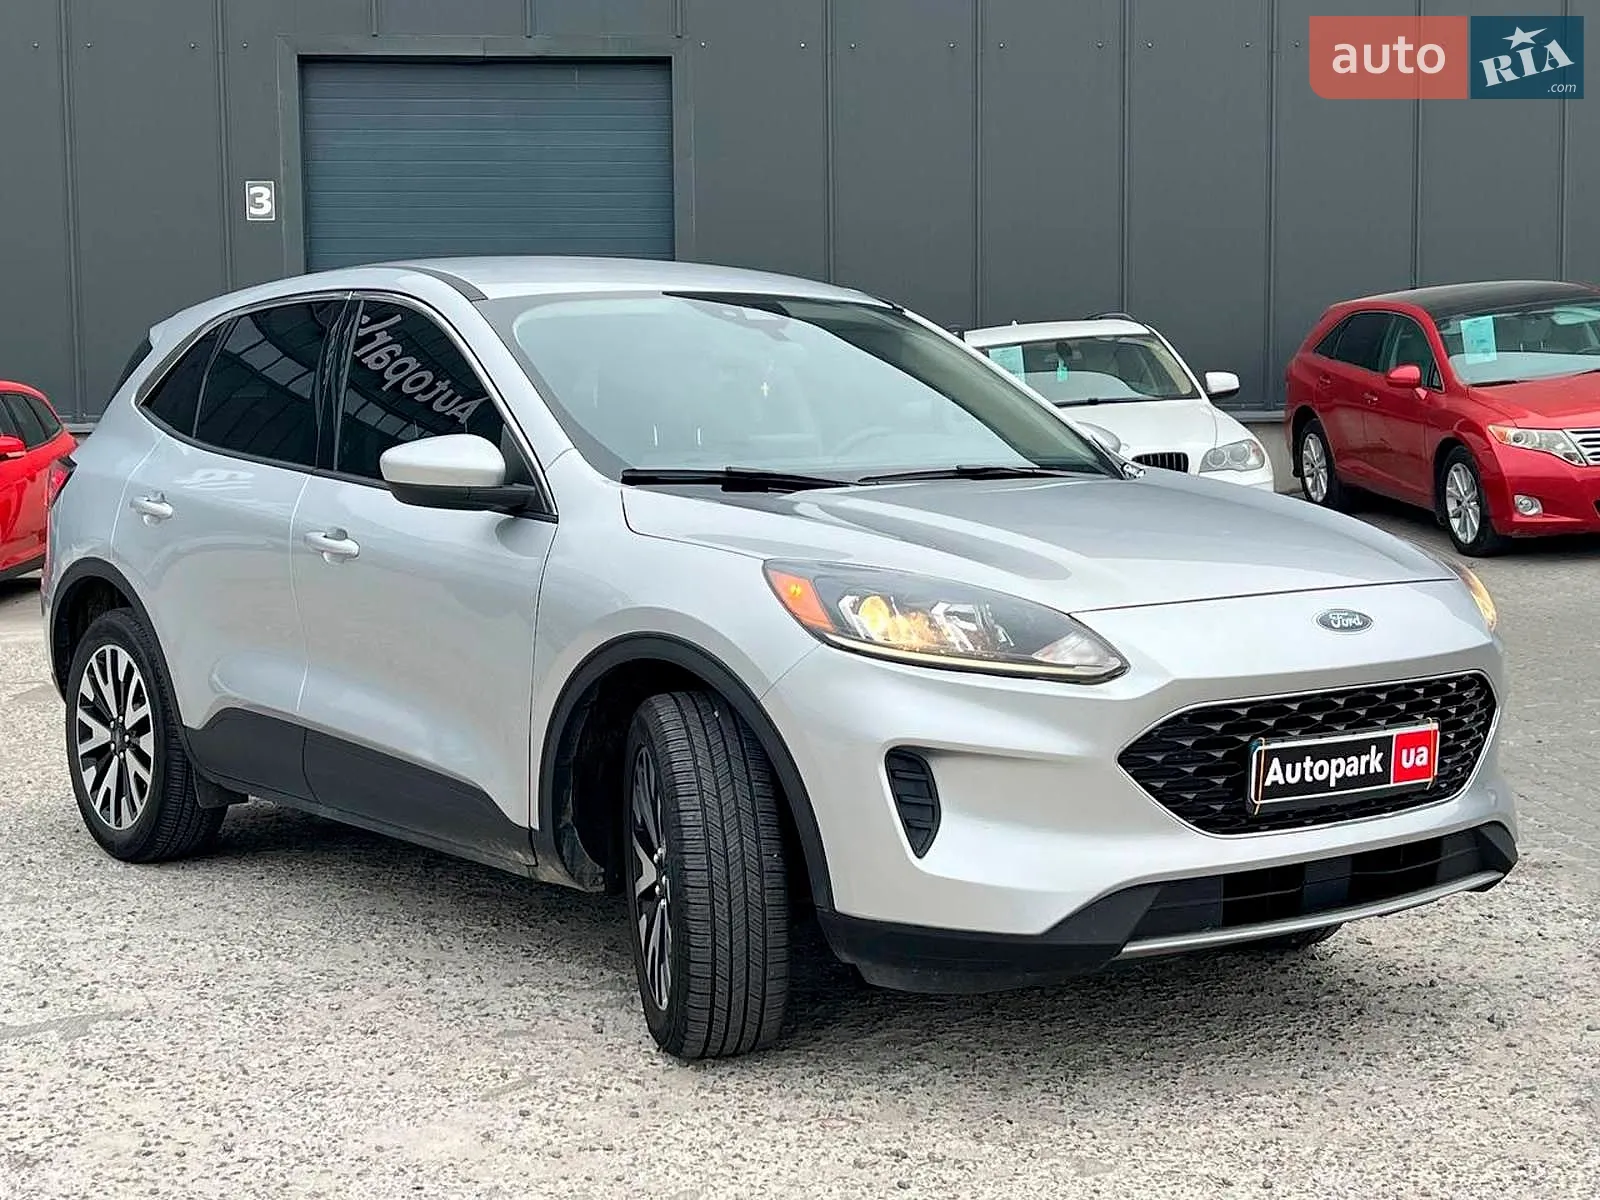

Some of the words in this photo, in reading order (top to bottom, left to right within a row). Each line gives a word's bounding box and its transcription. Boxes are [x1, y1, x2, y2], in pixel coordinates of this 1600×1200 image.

[249, 186, 272, 215] 3
[1328, 611, 1364, 629] Ford
[1264, 744, 1384, 788] Autopark
[1401, 745, 1429, 769] ua
